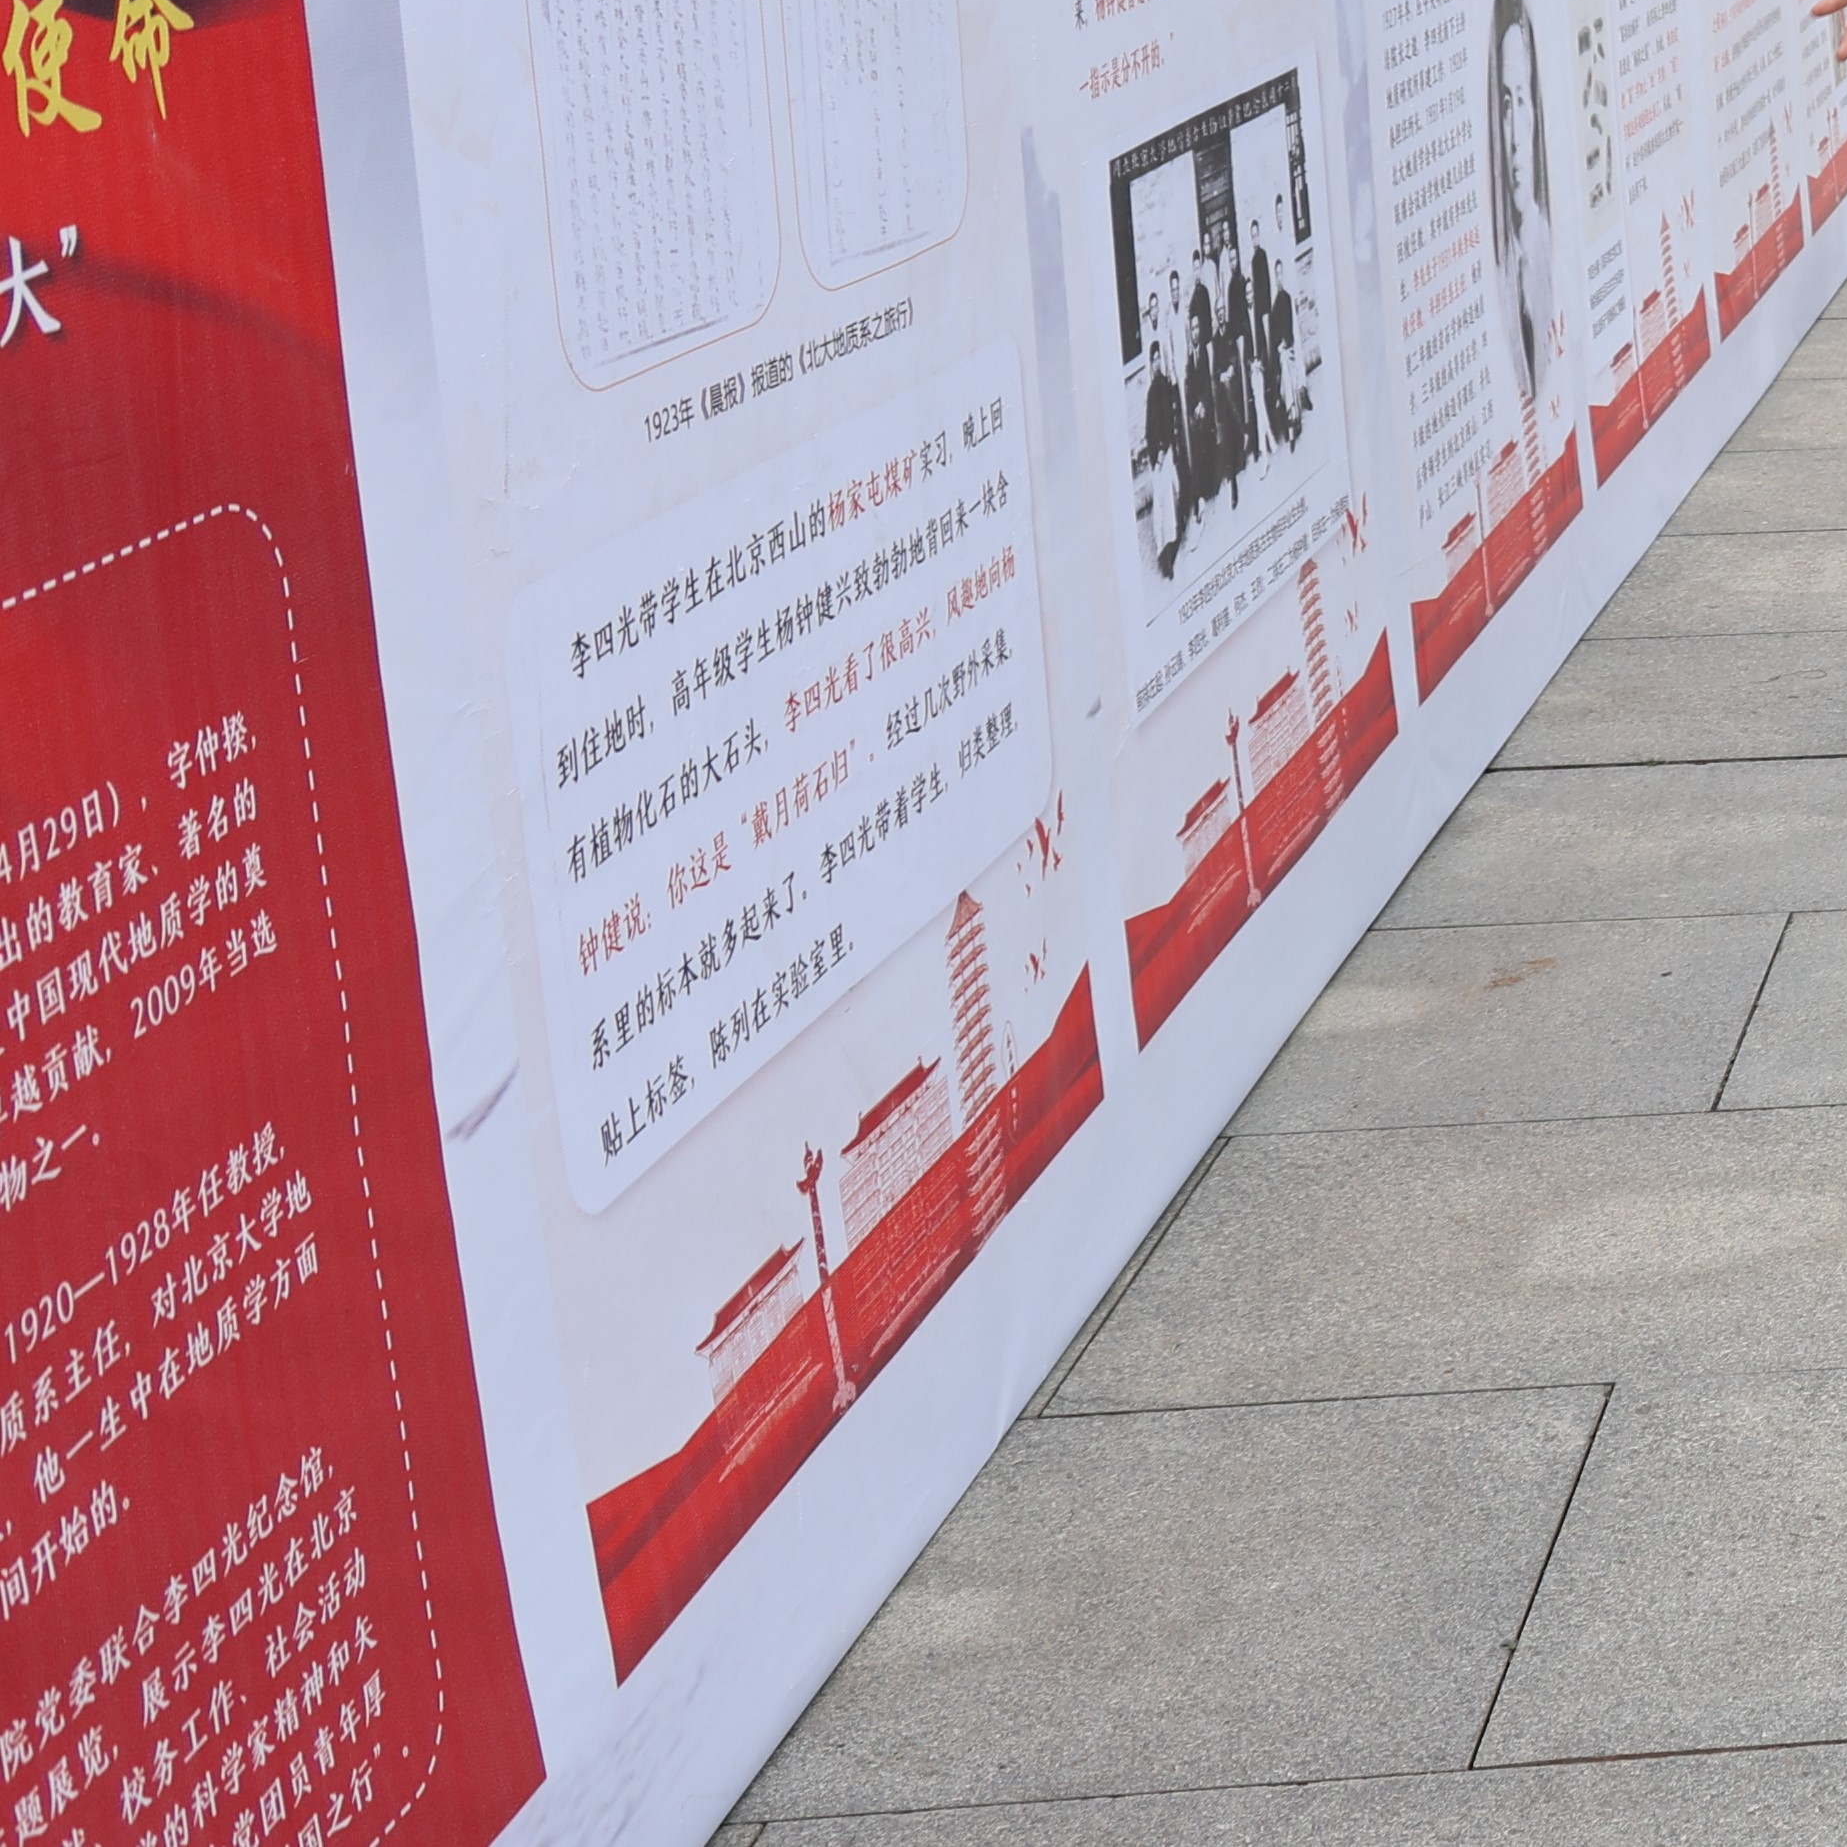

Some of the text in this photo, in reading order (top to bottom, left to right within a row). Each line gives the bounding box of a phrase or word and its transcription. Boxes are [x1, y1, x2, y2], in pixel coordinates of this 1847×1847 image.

[0, 909, 278, 1123] 越贡献，2009年当选
[0, 1486, 358, 1847] 题展览，展示李四光在北京
